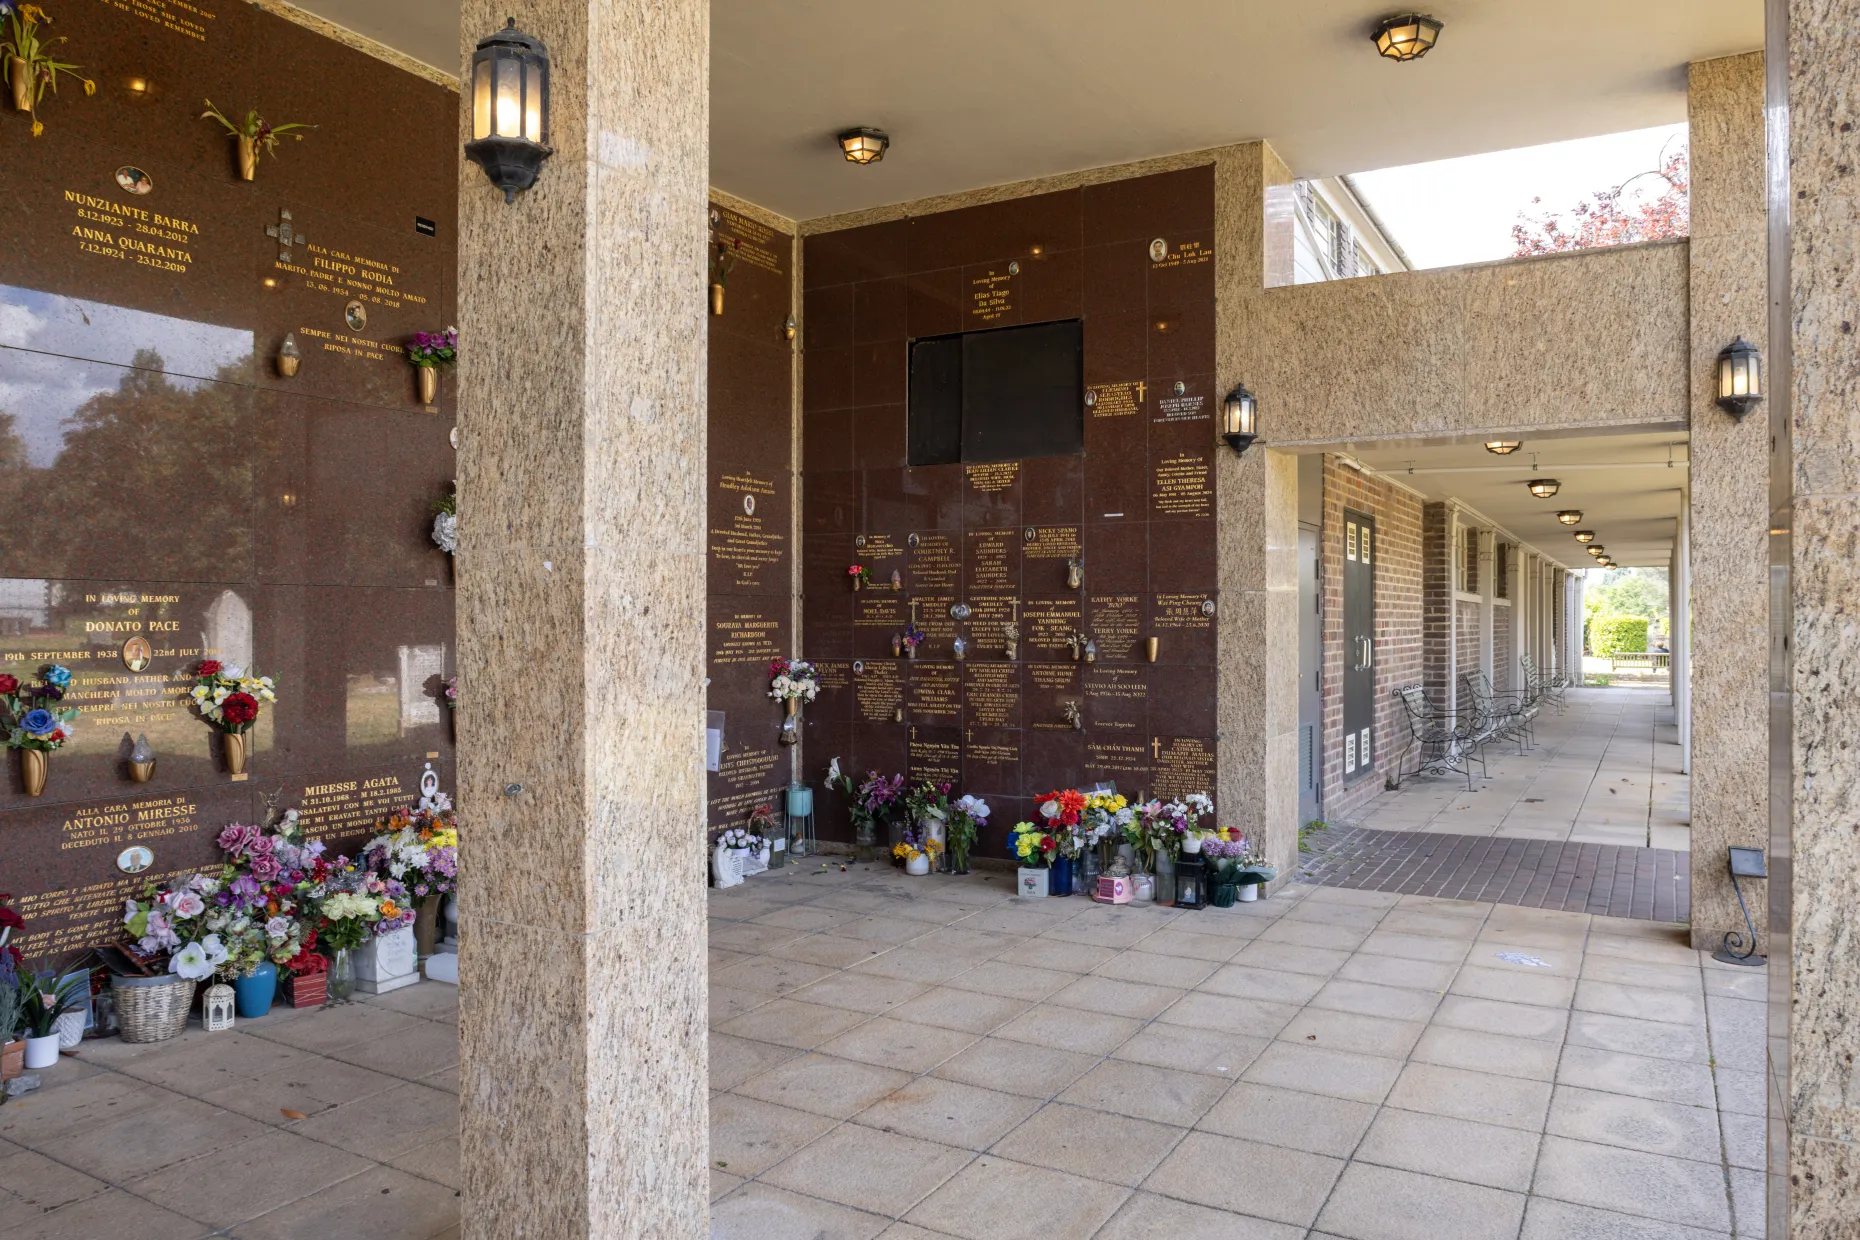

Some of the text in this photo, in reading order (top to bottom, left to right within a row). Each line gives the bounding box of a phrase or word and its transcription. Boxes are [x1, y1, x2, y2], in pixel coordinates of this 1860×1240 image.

[114, 1, 206, 41] SHE LOVED REMEMBER
[132, 0, 205, 32] THOSE SHE LOVED
[64, 190, 199, 234] NUNZIANTE BARRA
[77, 208, 188, 243] 8.12.1923 28.04.2012
[72, 225, 192, 263] ANNA QUARANTA
[80, 242, 186, 273] 7.12.1924 23.12.2019
[307, 244, 327, 255] ALLA
[330, 250, 350, 261] CARA
[354, 256, 388, 270] MEMORIA
[314, 257, 393, 285] FILIPPO RODIA
[310, 270, 334, 281] PADRE
[346, 279, 372, 290] NONNO
[376, 287, 400, 297] MOLTO
[403, 293, 426, 304] AMATO
[333, 287, 400, 308] 1934 2018
[300, 327, 331, 339] SEMPRE
[352, 337, 378, 348] NOSTRI
[381, 344, 405, 354] CUORI.
[324, 343, 351, 355] RIPOSA
[366, 352, 384, 361] PACE
[101, 595, 137, 603] LOVING
[141, 595, 180, 603] MEMORY
[86, 621, 180, 632] DONATO PACE
[4, 653, 25, 661] 19th
[31, 651, 91, 660] SEPTEMBER
[153, 649, 175, 657] 22nd
[180, 648, 199, 657] JULY
[135, 674, 192, 683] FATHER AND
[62, 689, 156, 701] MANCHERAI MOLTO
[78, 700, 176, 713] SEMPRE NEI NOSTRI
[136, 715, 146, 723] IN
[305, 776, 399, 796] MIRESSE AGATA
[310, 794, 350, 805] 31.10.1968
[370, 787, 402, 797] 18.2.1985
[394, 794, 415, 802] TUTTI
[76, 807, 100, 817] ALLA
[104, 804, 128, 813] CARA
[132, 799, 172, 810] MEMORIA
[328, 811, 361, 821] ERAVATE
[365, 807, 388, 816] TANTO
[62, 804, 197, 832] ANTONIO MIRESSE
[347, 818, 373, 827] MONDO
[70, 830, 95, 840] NATO
[128, 820, 167, 831] OTTOBRE
[172, 817, 191, 825] 1936
[340, 828, 366, 837] REGNO
[61, 837, 110, 850] DECEDUTO
[137, 828, 175, 839] GENNAIO
[20, 895, 38, 903] MIO
[41, 890, 68, 900] CORPO
[82, 882, 114, 893] ANDATO
[117, 879, 129, 887] MA
[22, 886, 134, 912] TUTTO CHE CHE
[41, 905, 74, 917] SPIRITO
[68, 905, 123, 920] TENETE VIVO
[11, 936, 24, 945] MY
[29, 931, 53, 941] BODY
[68, 923, 91, 933] GONE
[94, 920, 110, 929] BUT
[53, 938, 68, 946] SEE
[86, 928, 110, 938] HEAR
[63, 942, 90, 953] LONG
[88, 938, 100, 947] AS
